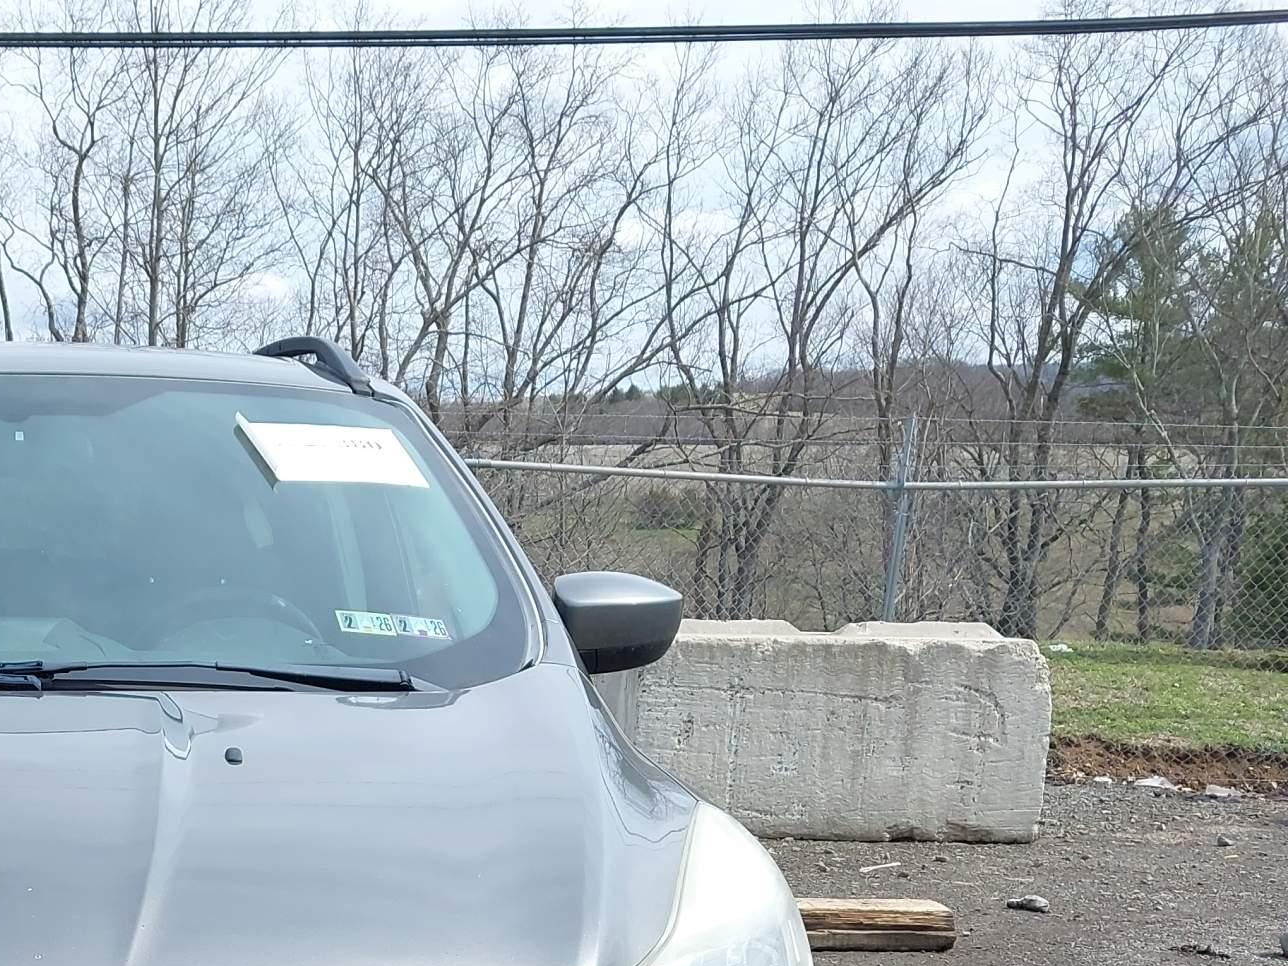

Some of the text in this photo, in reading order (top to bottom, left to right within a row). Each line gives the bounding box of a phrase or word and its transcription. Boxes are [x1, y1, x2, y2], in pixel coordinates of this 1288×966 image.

[344, 615, 393, 632] 2 26
[399, 619, 447, 636] 2 26
